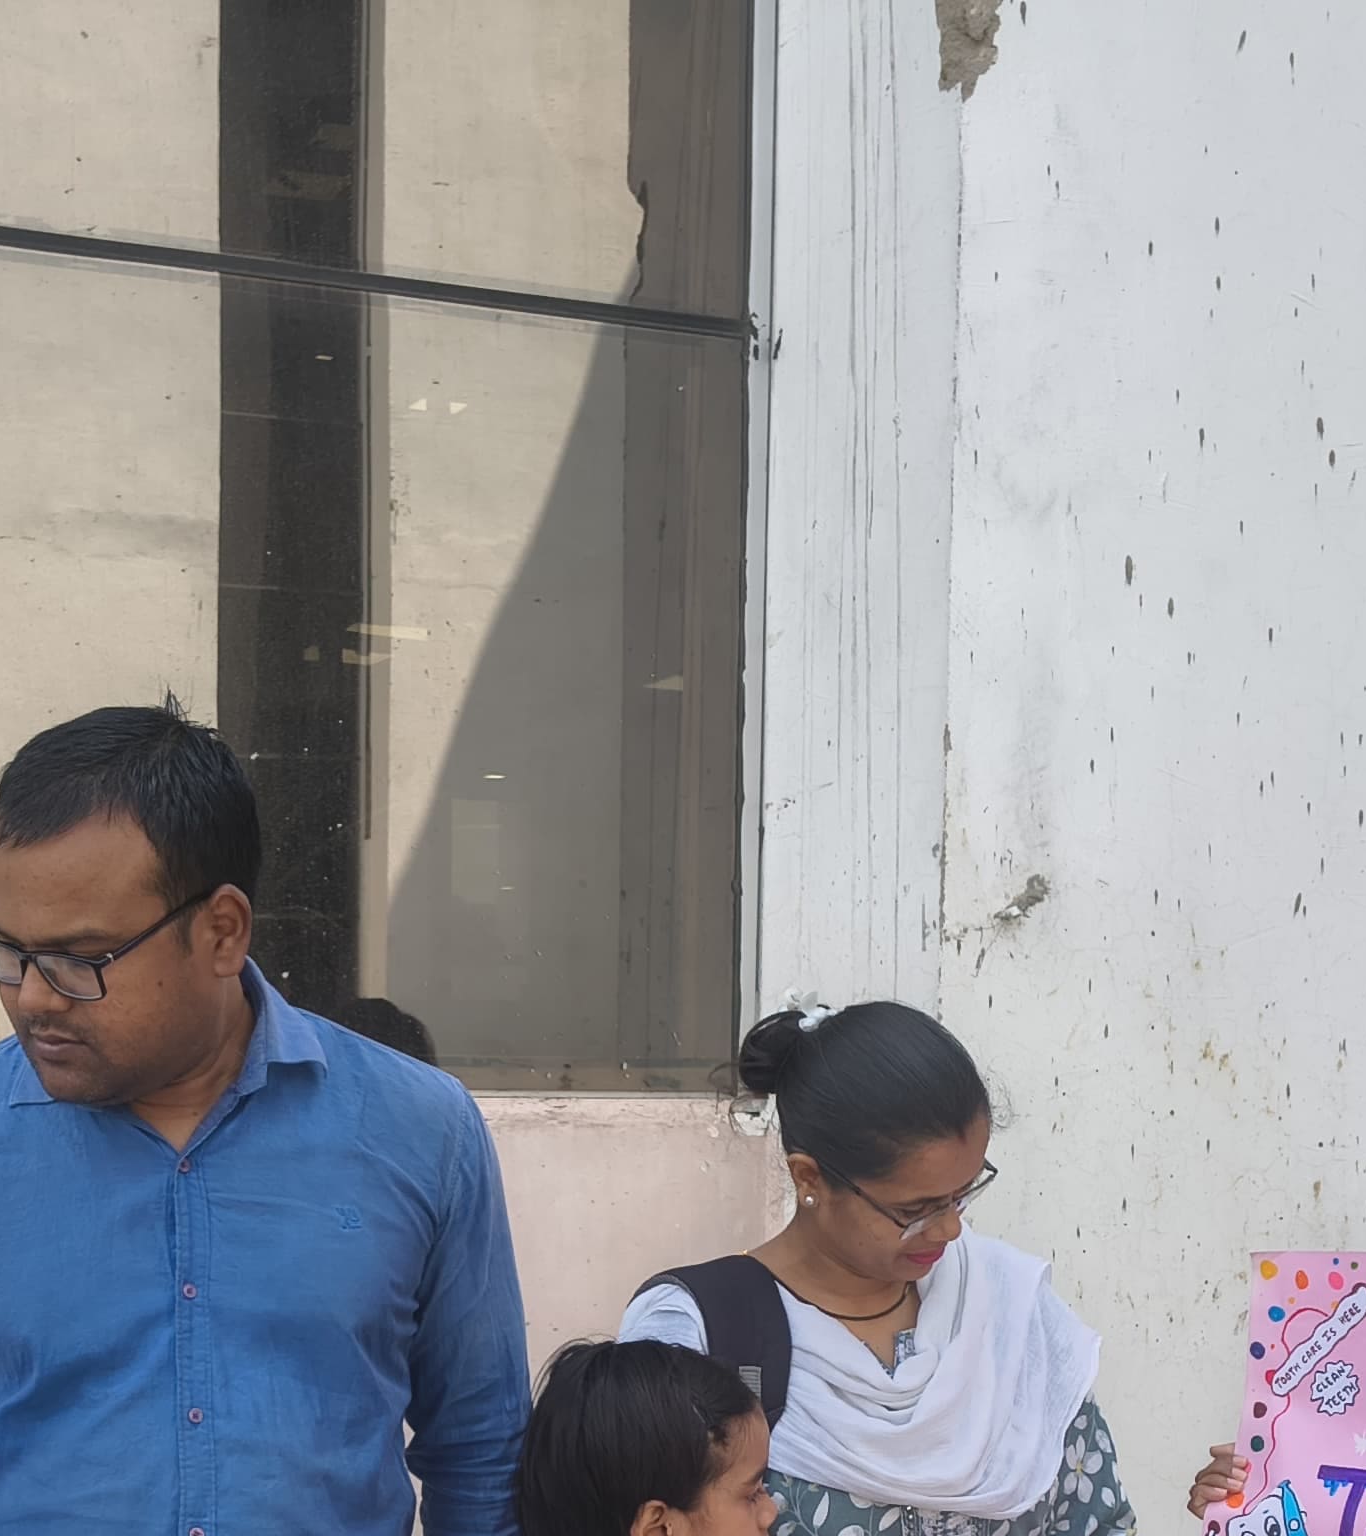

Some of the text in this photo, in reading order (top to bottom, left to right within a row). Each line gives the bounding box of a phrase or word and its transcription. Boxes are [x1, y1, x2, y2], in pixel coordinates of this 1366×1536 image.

[1274, 1302, 1362, 1389] TOOTH CARE IS HERE
[1316, 1366, 1346, 1393] CLEAN
[1325, 1382, 1357, 1409] TEETH
